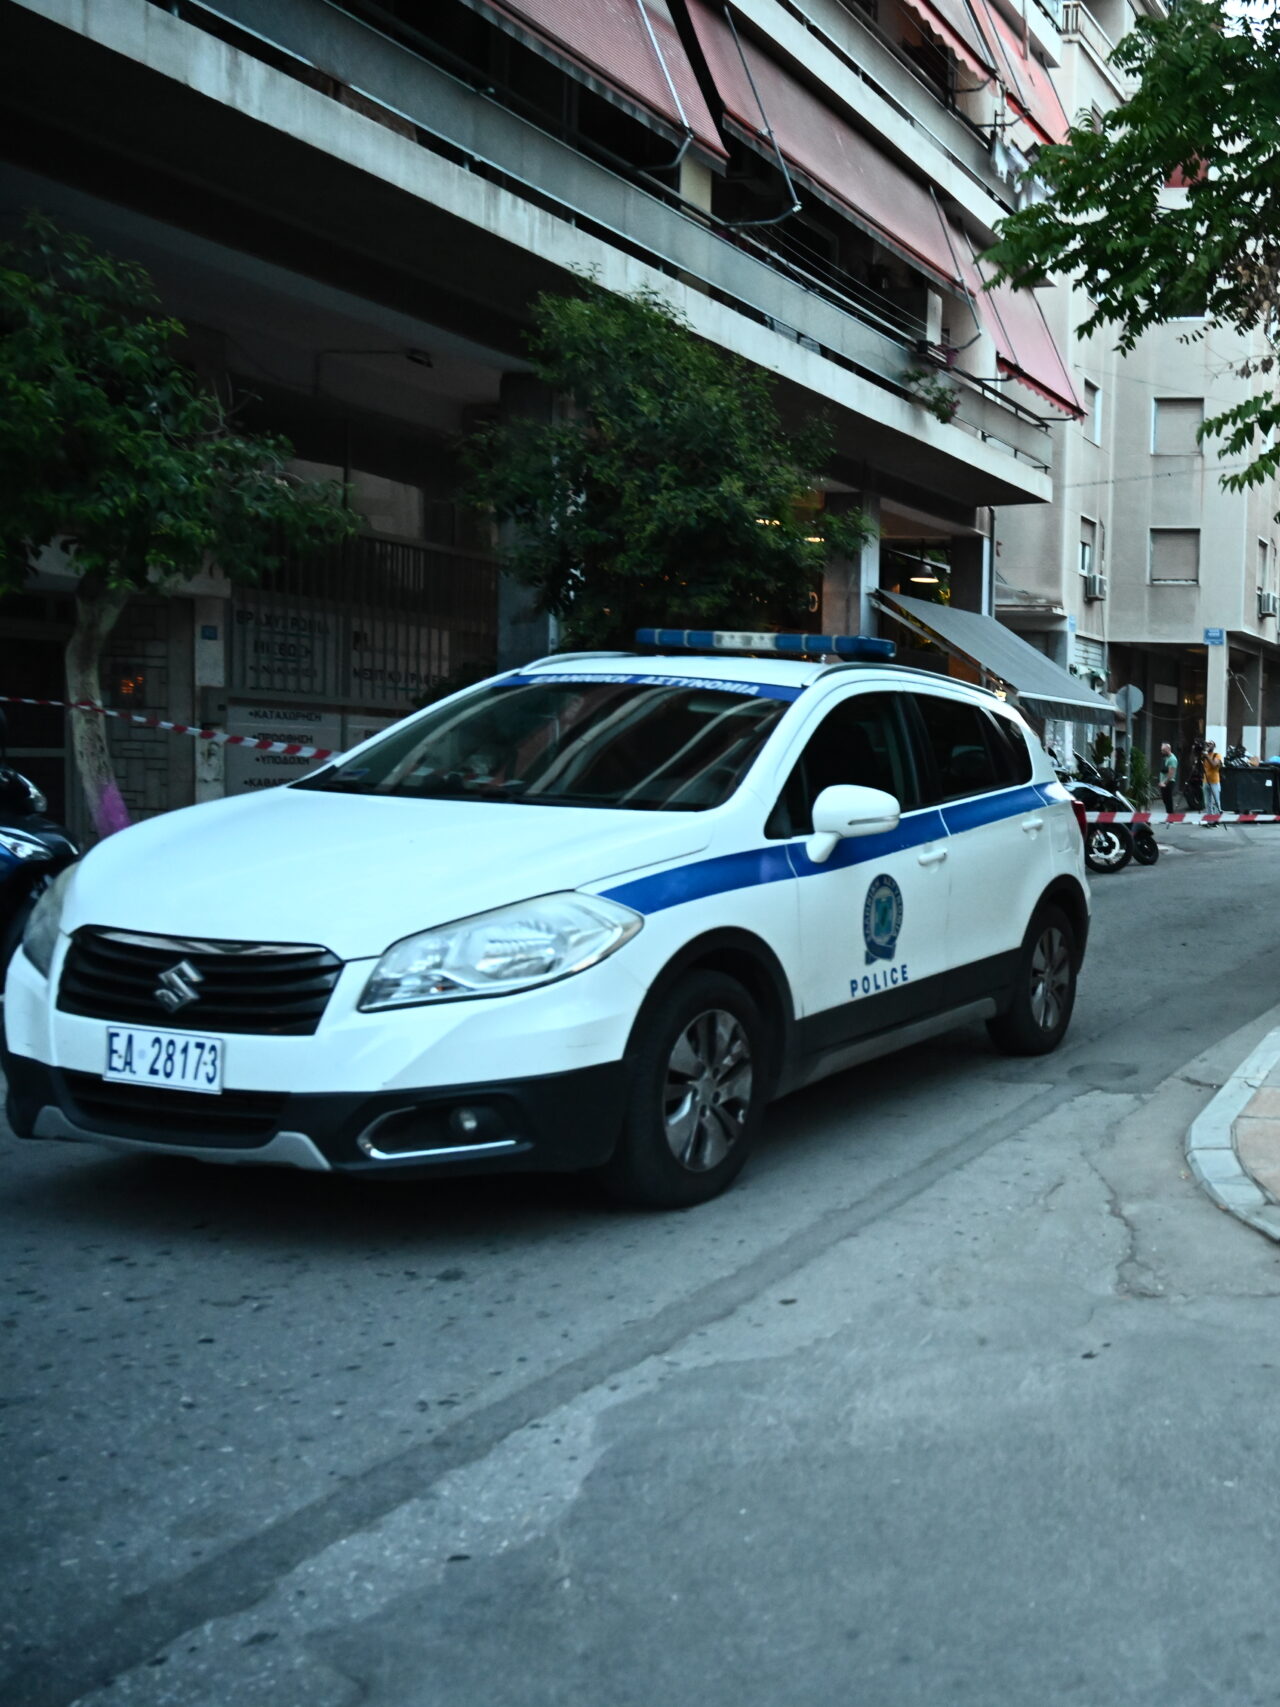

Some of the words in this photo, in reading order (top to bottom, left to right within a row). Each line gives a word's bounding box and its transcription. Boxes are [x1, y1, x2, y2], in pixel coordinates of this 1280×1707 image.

[638, 676, 760, 695] ΑΣΤΥΝΟΜΙΑ
[850, 964, 909, 997] POLICE
[108, 1032, 136, 1074] EA
[148, 1036, 218, 1085] 28173
